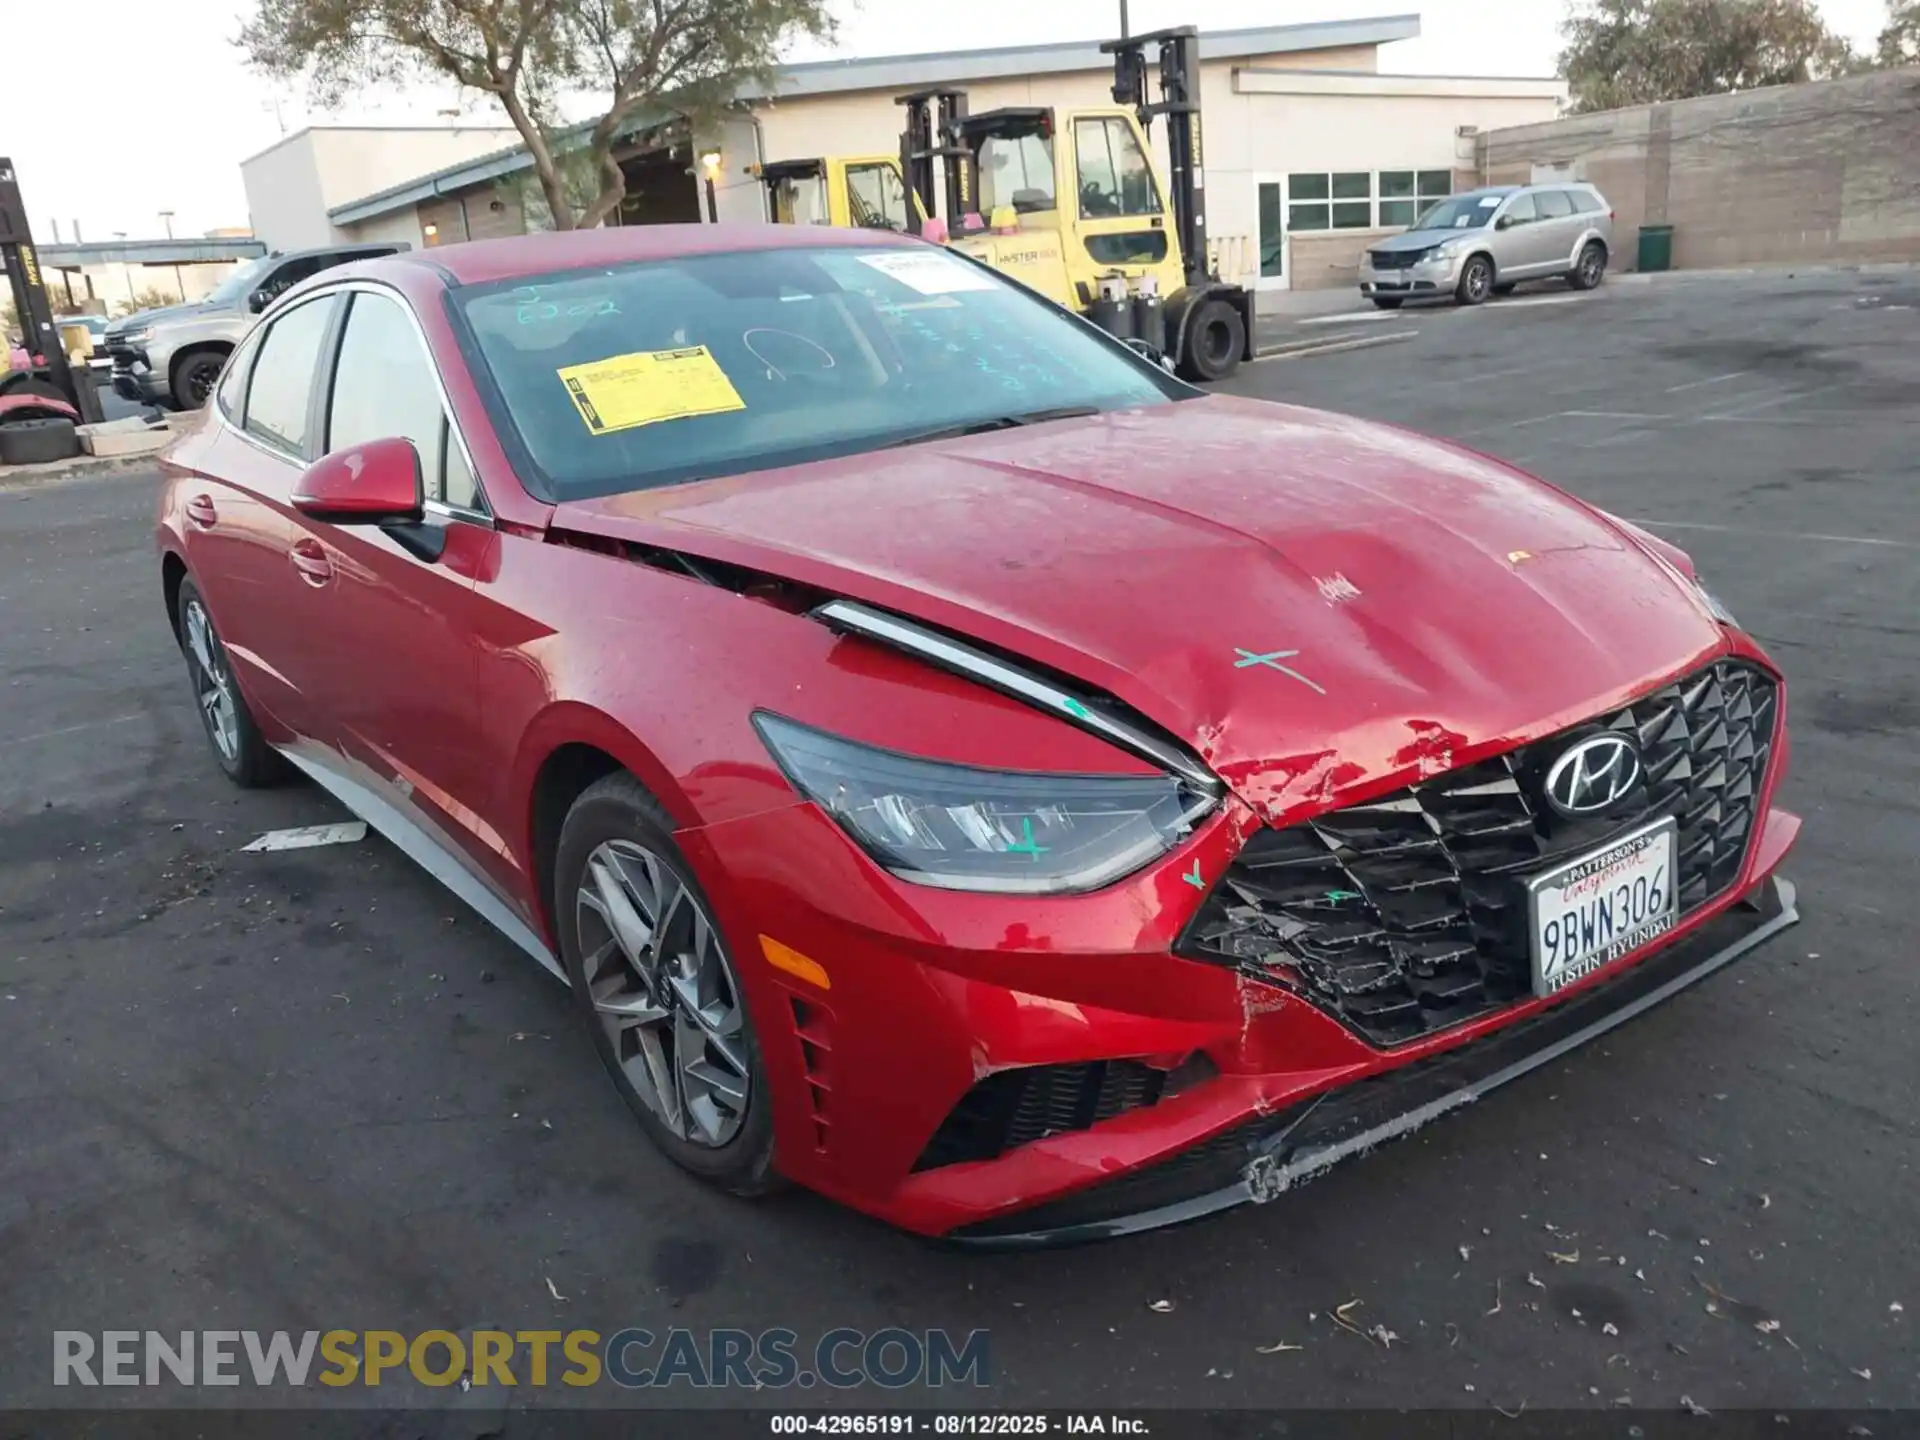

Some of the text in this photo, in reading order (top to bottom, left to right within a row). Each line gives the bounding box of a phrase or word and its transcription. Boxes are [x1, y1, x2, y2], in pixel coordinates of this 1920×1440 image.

[1569, 836, 1648, 882] PATTERSON'S
[1544, 864, 1664, 976] 9BWN306
[1549, 915, 1673, 992] TUSTIN HYUNDAI
